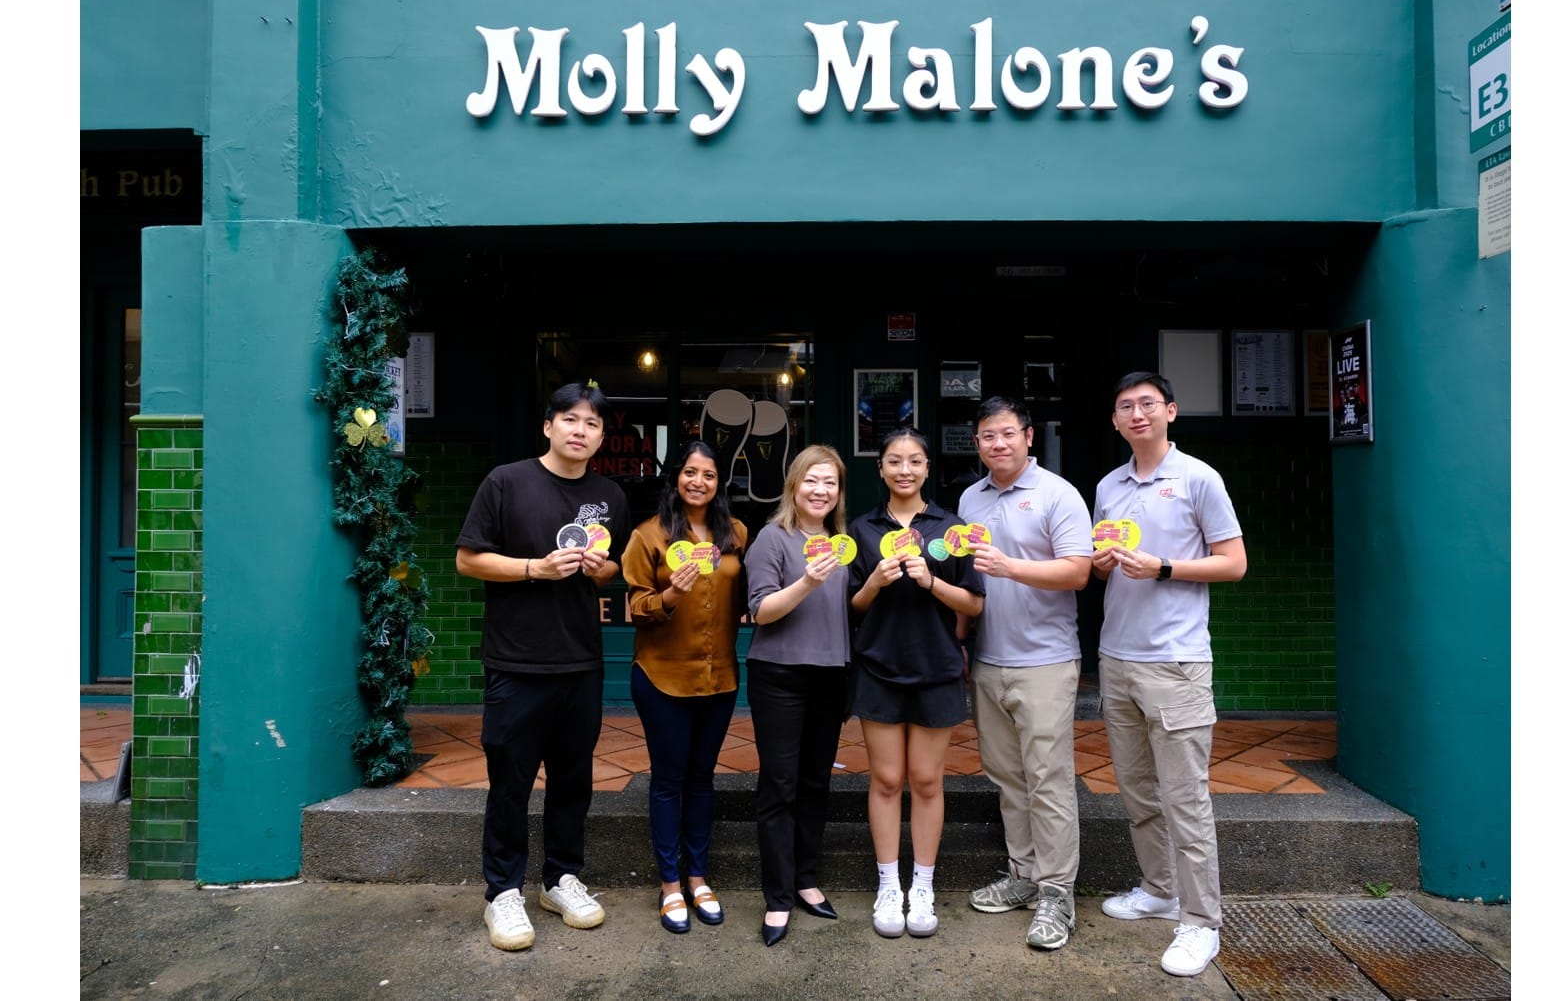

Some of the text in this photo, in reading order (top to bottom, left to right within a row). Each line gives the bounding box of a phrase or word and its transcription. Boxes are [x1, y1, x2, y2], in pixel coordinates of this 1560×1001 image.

[466, 15, 1249, 136] Molly Malone's
[1478, 72, 1509, 120] E3
[115, 167, 184, 198] Pub
[1337, 356, 1360, 375] LIVE
